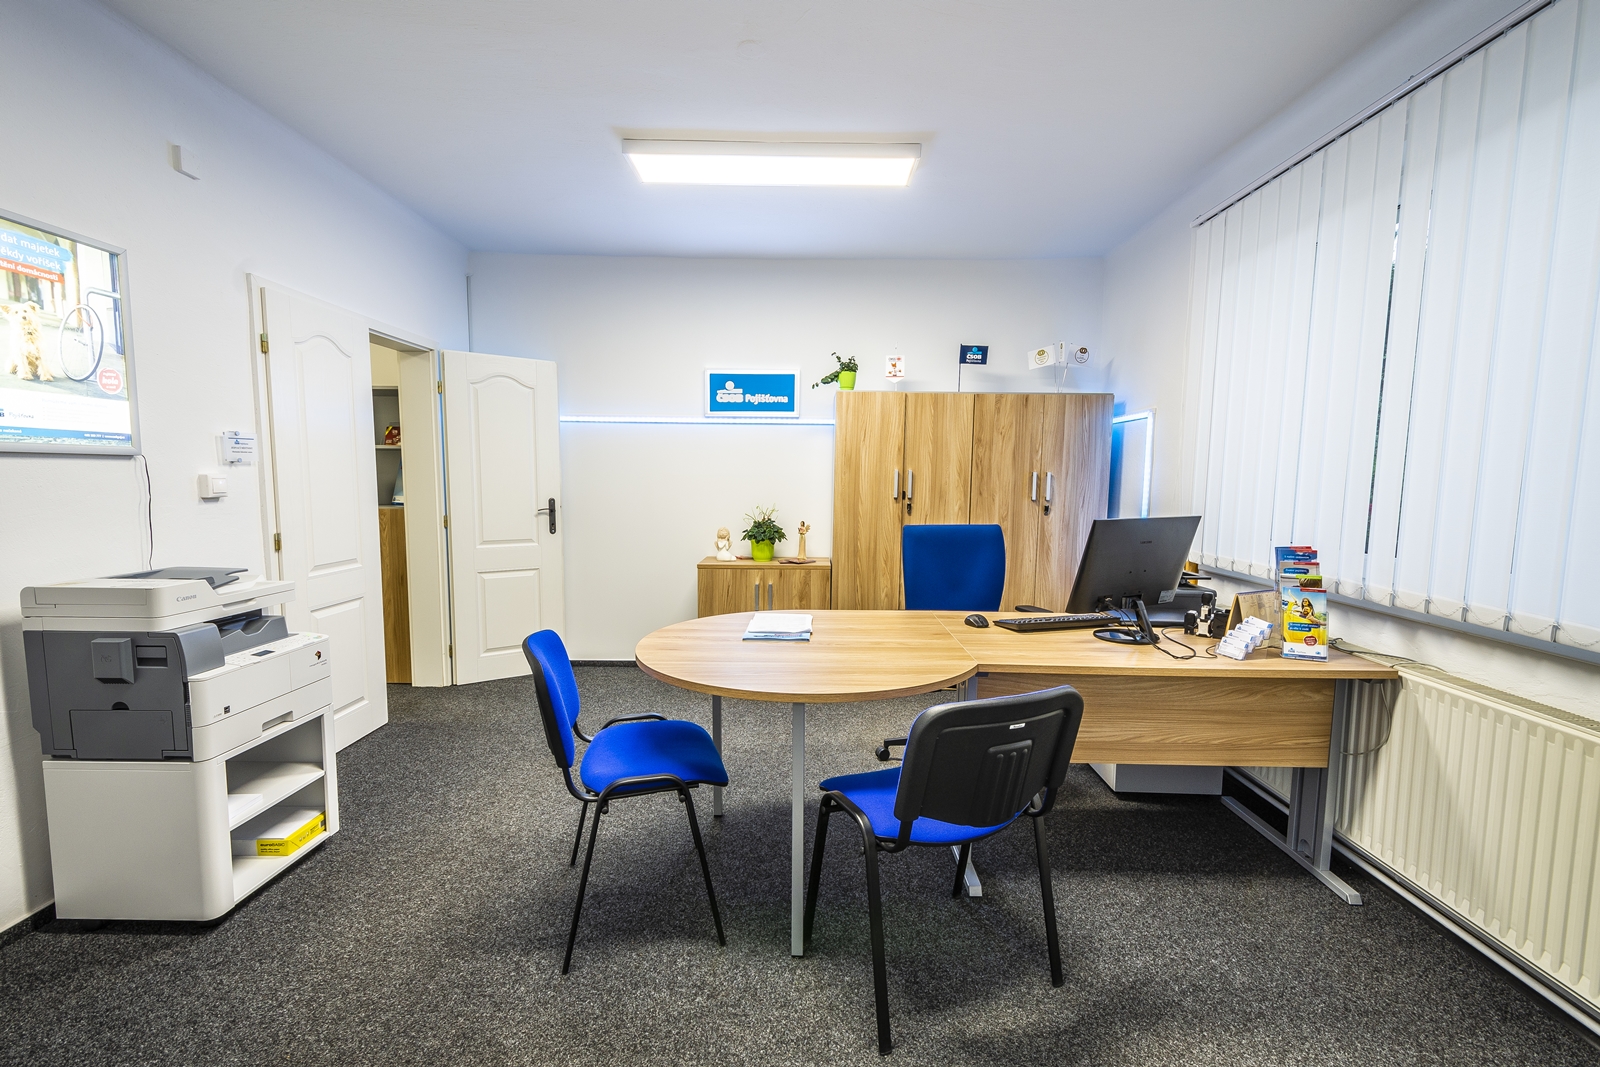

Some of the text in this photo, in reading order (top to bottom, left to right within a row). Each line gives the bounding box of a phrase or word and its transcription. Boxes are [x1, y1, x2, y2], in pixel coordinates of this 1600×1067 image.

[20, 240, 60, 257] majetek
[0, 246, 61, 271] ěkdy voříšek
[16, 265, 59, 281] domácnosti
[745, 393, 788, 405] Pojišťovna
[176, 594, 197, 602] Canon
